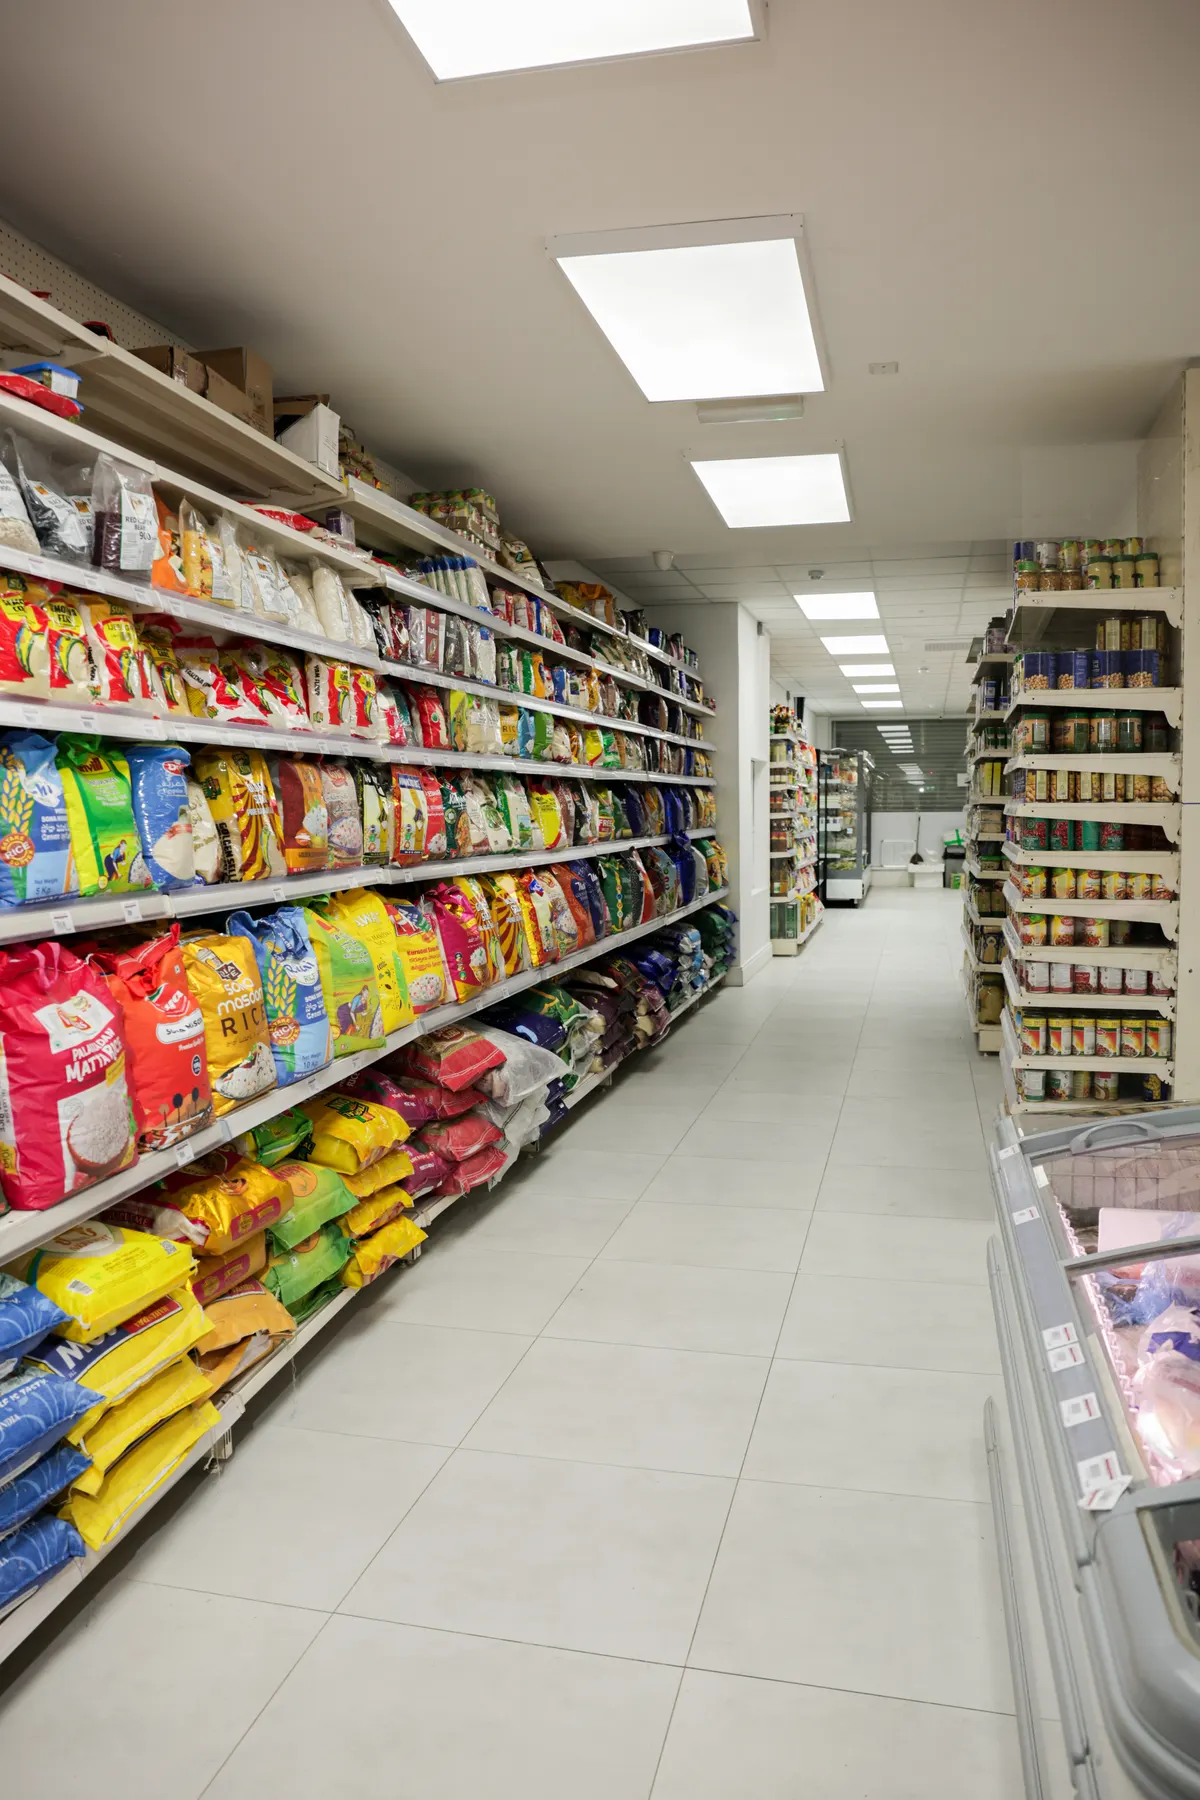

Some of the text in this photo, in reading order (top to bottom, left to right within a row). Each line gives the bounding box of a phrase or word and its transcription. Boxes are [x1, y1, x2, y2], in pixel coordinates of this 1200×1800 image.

[4, 841, 31, 860] RICE
[220, 1003, 266, 1037] RICE
[271, 1023, 297, 1039] RICE
[65, 1051, 112, 1083] MATTA
